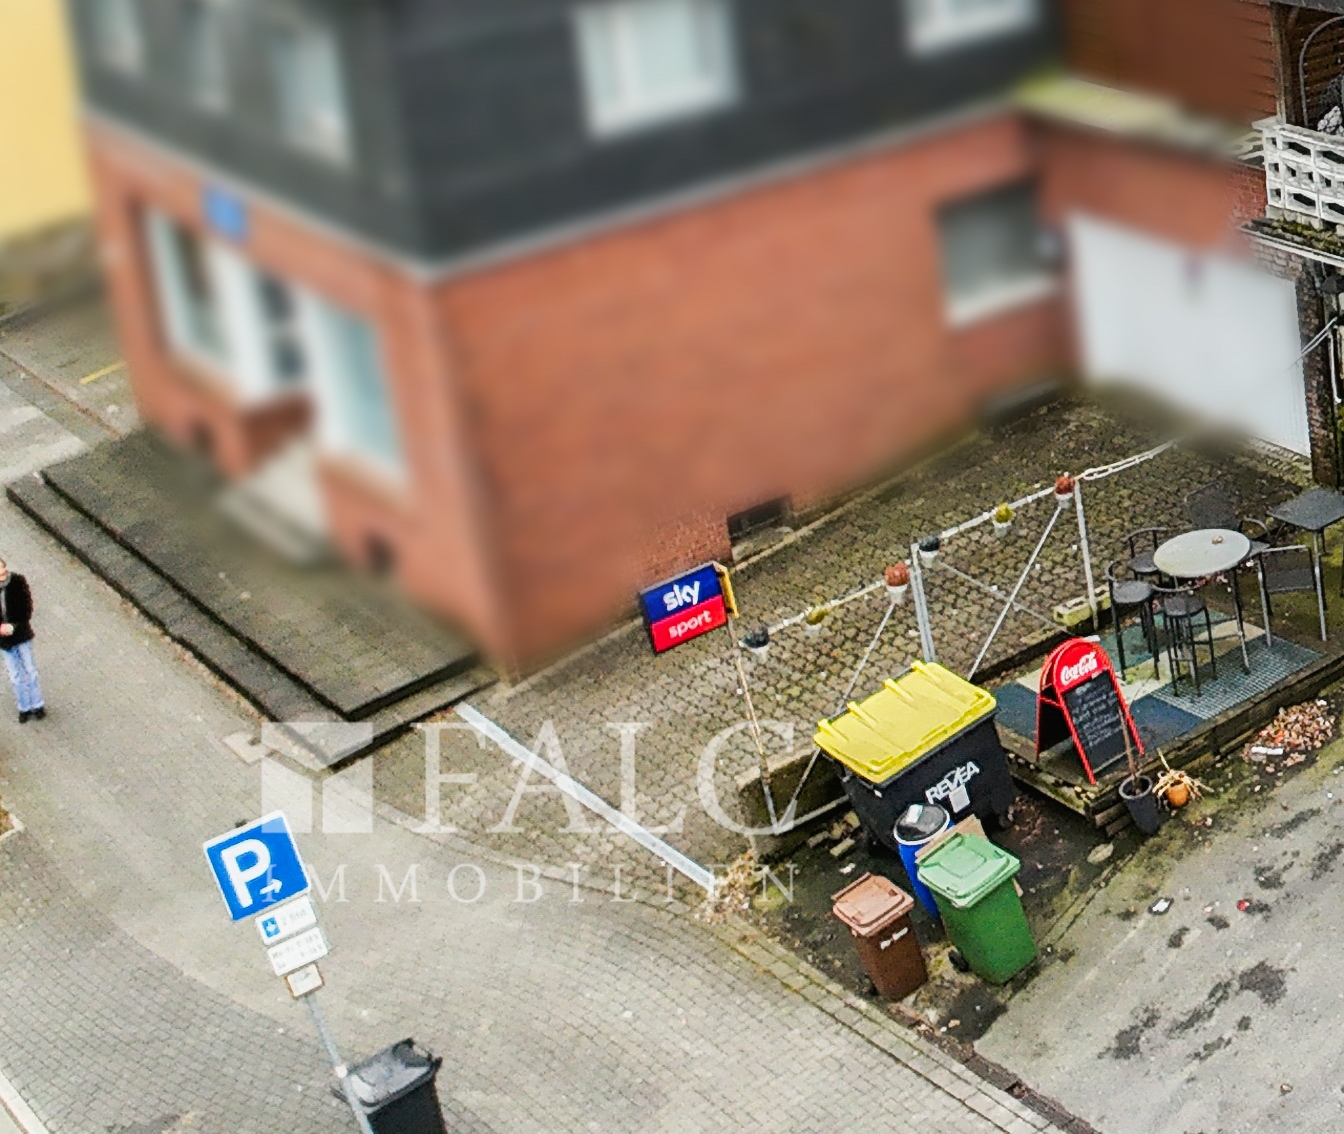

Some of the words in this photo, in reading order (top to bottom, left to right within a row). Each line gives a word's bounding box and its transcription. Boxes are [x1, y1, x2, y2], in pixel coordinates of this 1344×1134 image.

[663, 580, 700, 611] sky
[668, 609, 713, 639] sport
[220, 838, 272, 908] P
